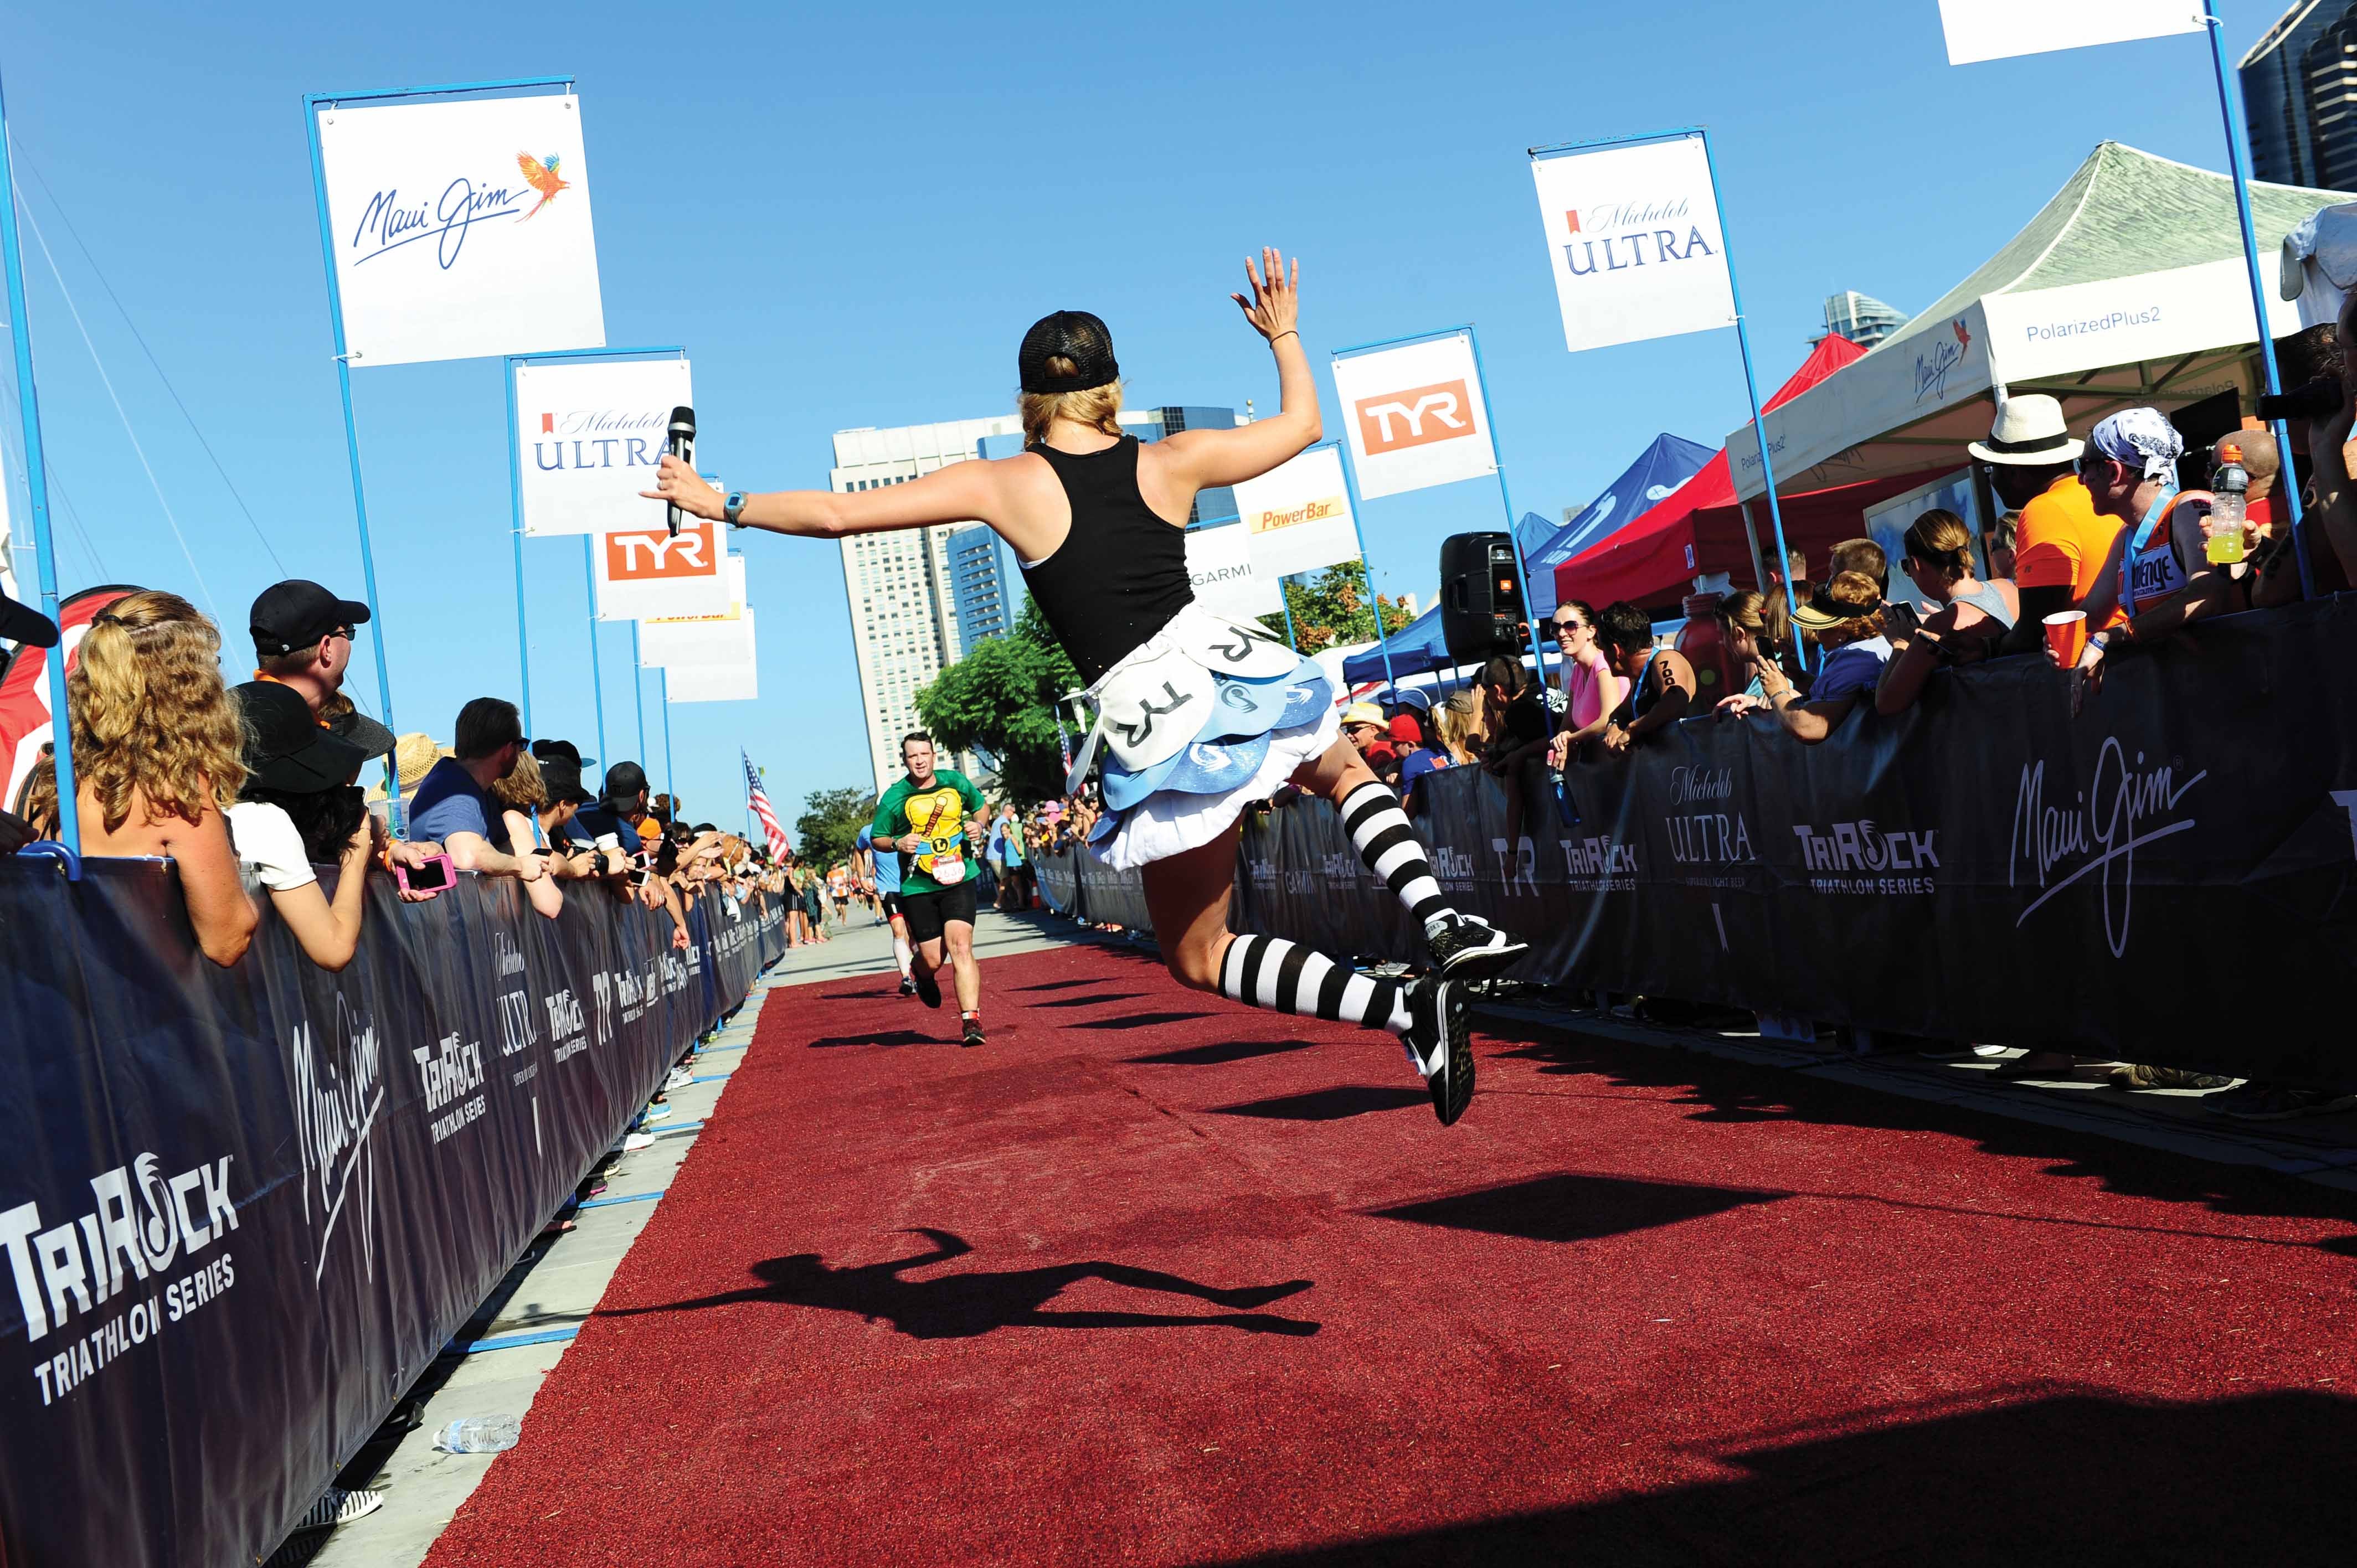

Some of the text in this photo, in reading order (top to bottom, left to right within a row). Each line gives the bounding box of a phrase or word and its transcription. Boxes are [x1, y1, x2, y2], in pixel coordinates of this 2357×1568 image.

[353, 178, 529, 270] Maui Jim
[1586, 197, 1689, 233] Michelob
[1563, 225, 1714, 276] ULTRA
[2026, 306, 2162, 342] PolarizedPlus2
[559, 410, 665, 435] Michelob
[1365, 391, 1463, 443] TYR
[1262, 501, 1331, 530] PowerBar
[614, 532, 704, 572] TYR
[1191, 563, 1252, 586] GARMI
[1670, 764, 1732, 806] Michelob
[934, 839, 946, 852] L
[1665, 811, 1756, 863] ULTRA
[2009, 759, 2088, 889] Maui
[2092, 736, 2207, 958] Jim
[1492, 836, 1540, 897] TR
[1605, 878, 1635, 891] SERIES
[1810, 876, 1935, 895] TRIATHLON SERIES
[34, 1253, 235, 1406] TRIATHLON SERIES
